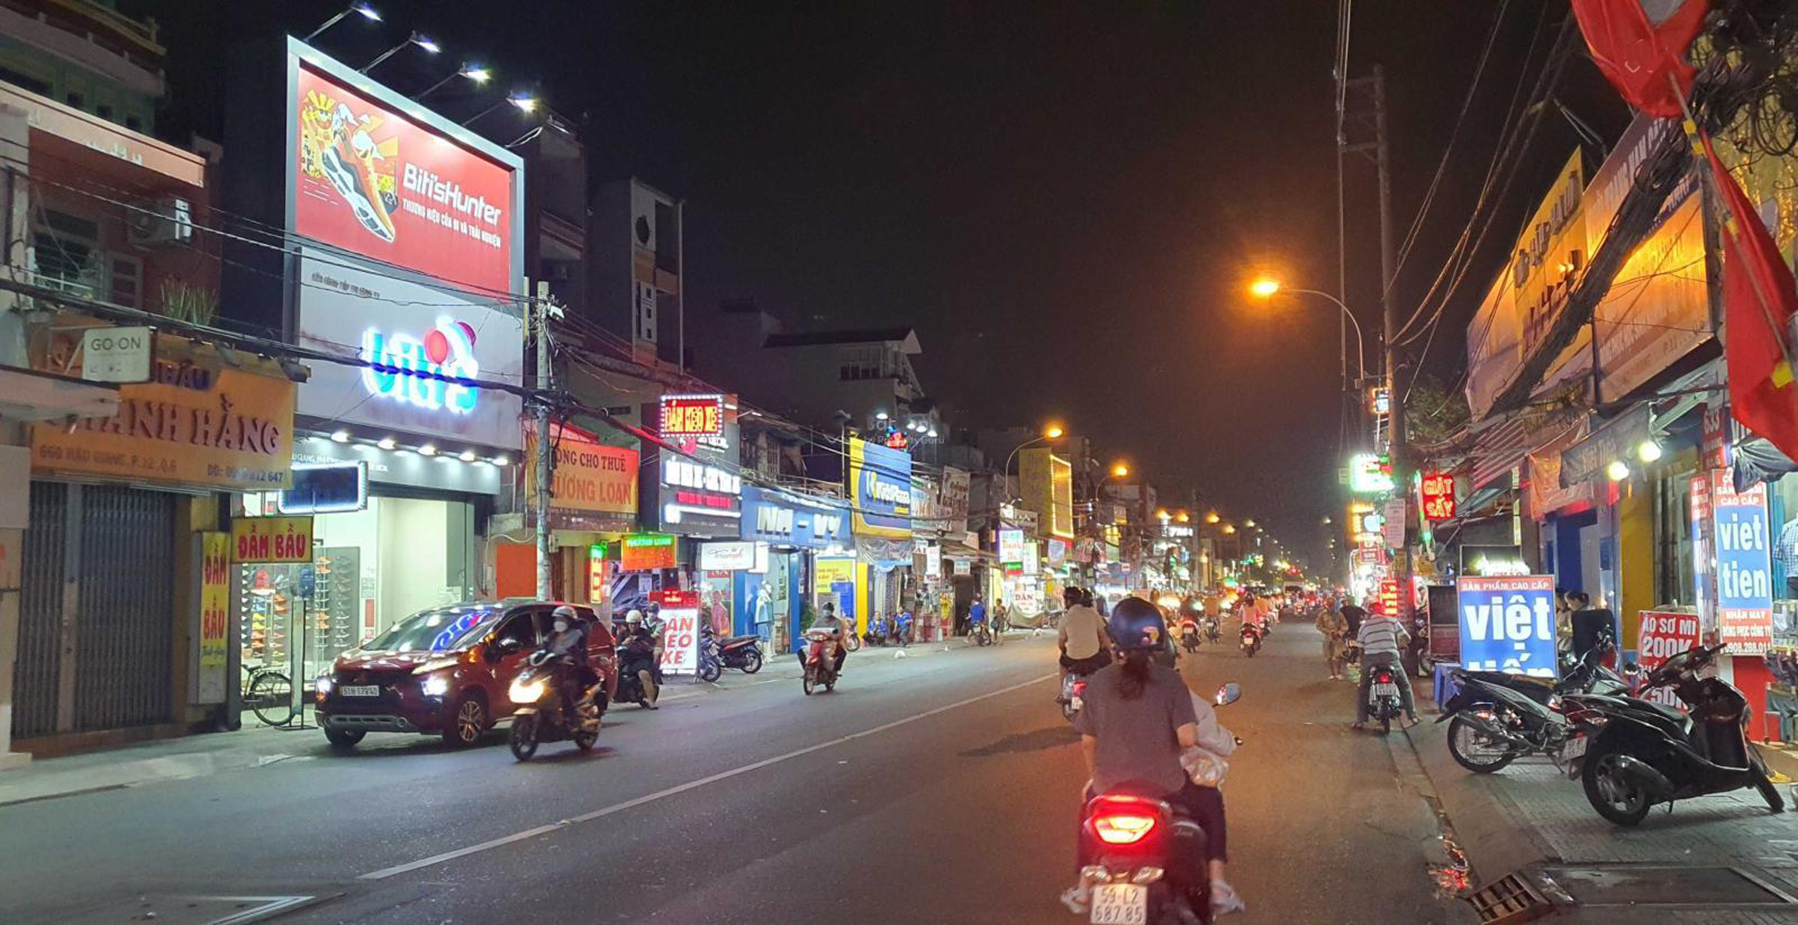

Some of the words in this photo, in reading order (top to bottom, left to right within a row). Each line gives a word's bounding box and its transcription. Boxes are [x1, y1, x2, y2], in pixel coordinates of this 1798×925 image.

[579, 452, 600, 469] CHO
[599, 479, 632, 505] LOAN
[1511, 582, 1529, 591] CAO
[1464, 594, 1552, 651] việt
[1678, 618, 1696, 636] MI
